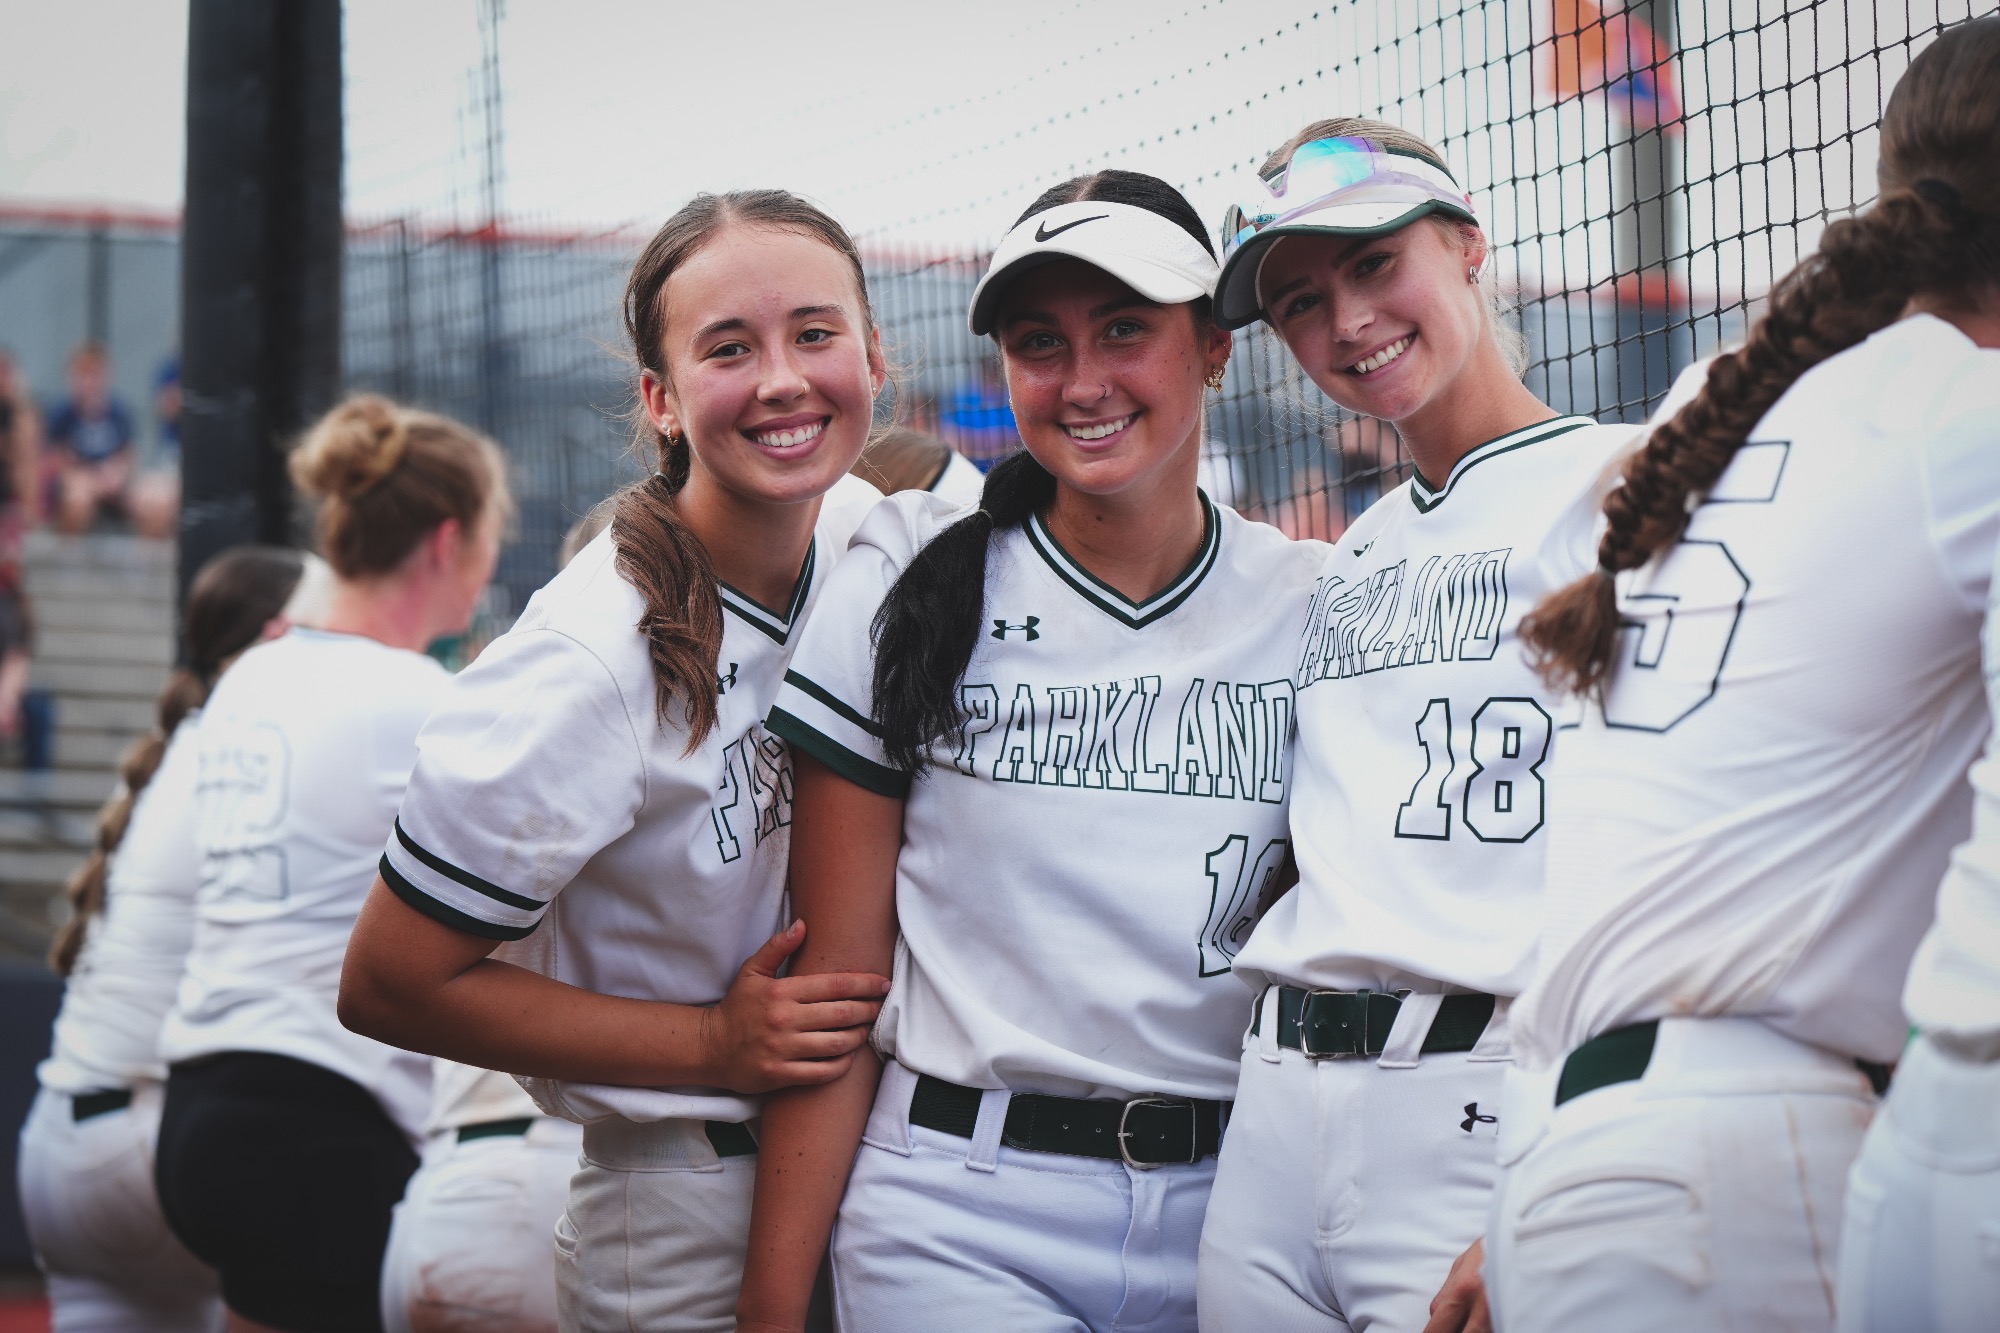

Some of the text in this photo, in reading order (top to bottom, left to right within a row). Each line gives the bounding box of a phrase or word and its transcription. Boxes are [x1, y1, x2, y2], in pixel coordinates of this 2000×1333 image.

[1296, 547, 1513, 691] ARKLAND
[953, 675, 1296, 805] PARKLAND
[1394, 696, 1553, 844] 18
